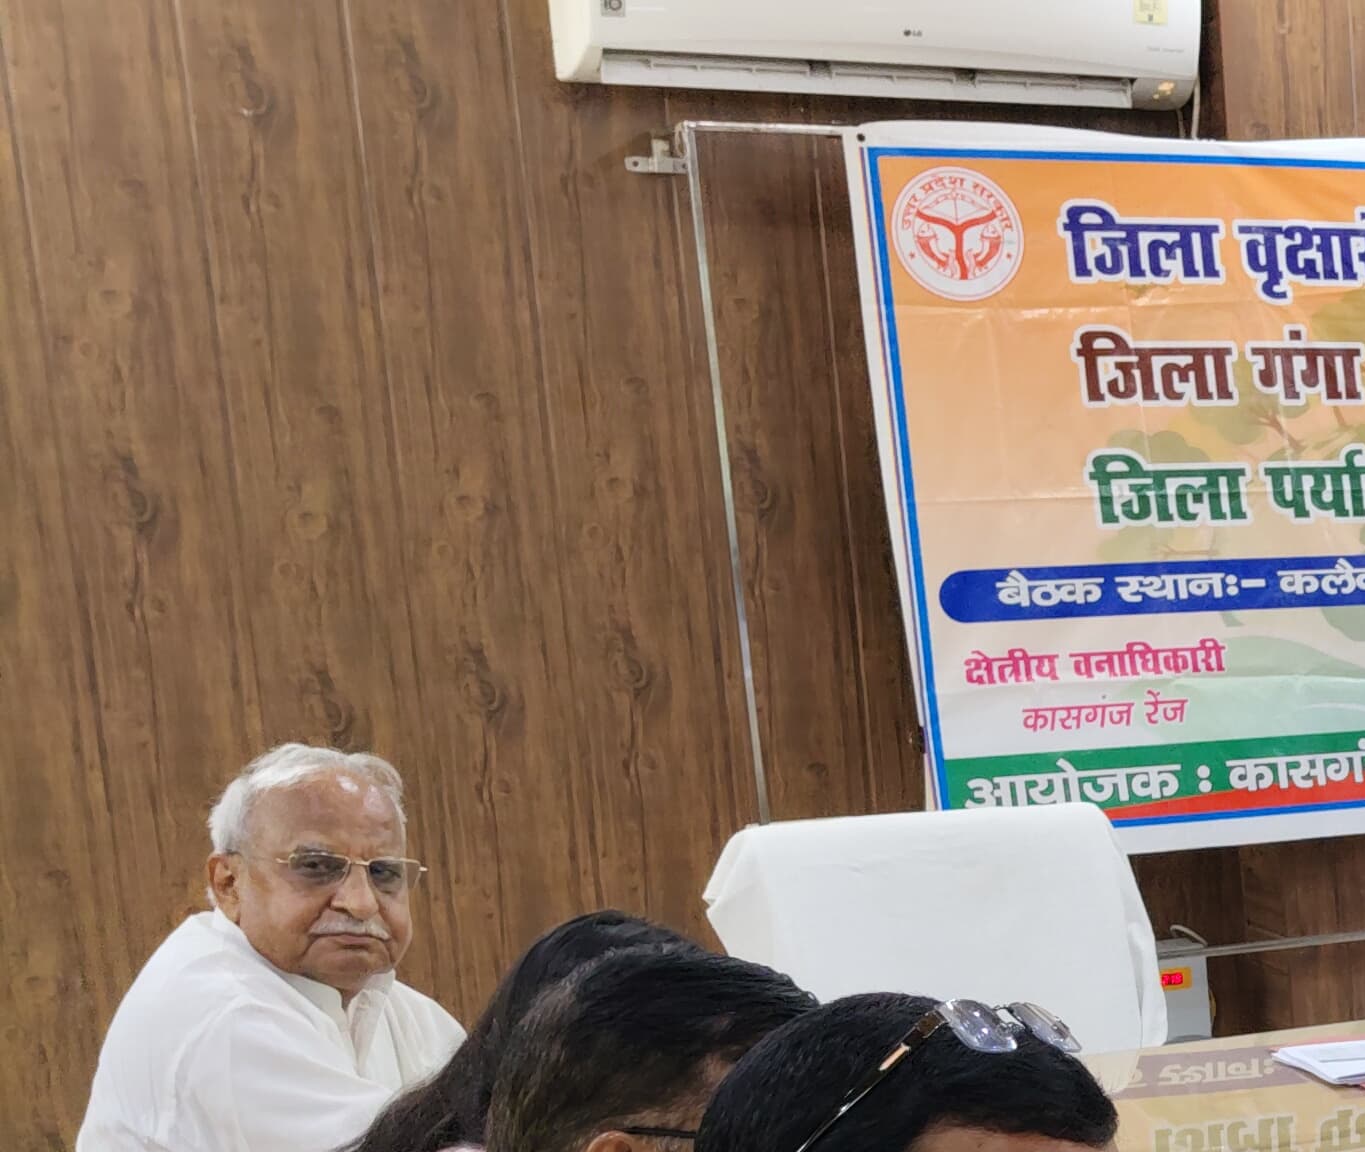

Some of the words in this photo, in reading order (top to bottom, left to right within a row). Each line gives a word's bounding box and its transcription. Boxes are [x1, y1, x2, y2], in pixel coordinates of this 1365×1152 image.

[1063, 205, 1221, 278] जिला
[1076, 331, 1233, 402] जिला
[1250, 329, 1362, 401] गंगा
[1089, 454, 1248, 525] जिला
[996, 570, 1105, 608] बैठक
[1068, 637, 1226, 680] वनाधिकारी
[1021, 694, 1136, 733] कासगंज
[1143, 689, 1189, 724] रेंज
[964, 757, 1182, 809] आयोजक
